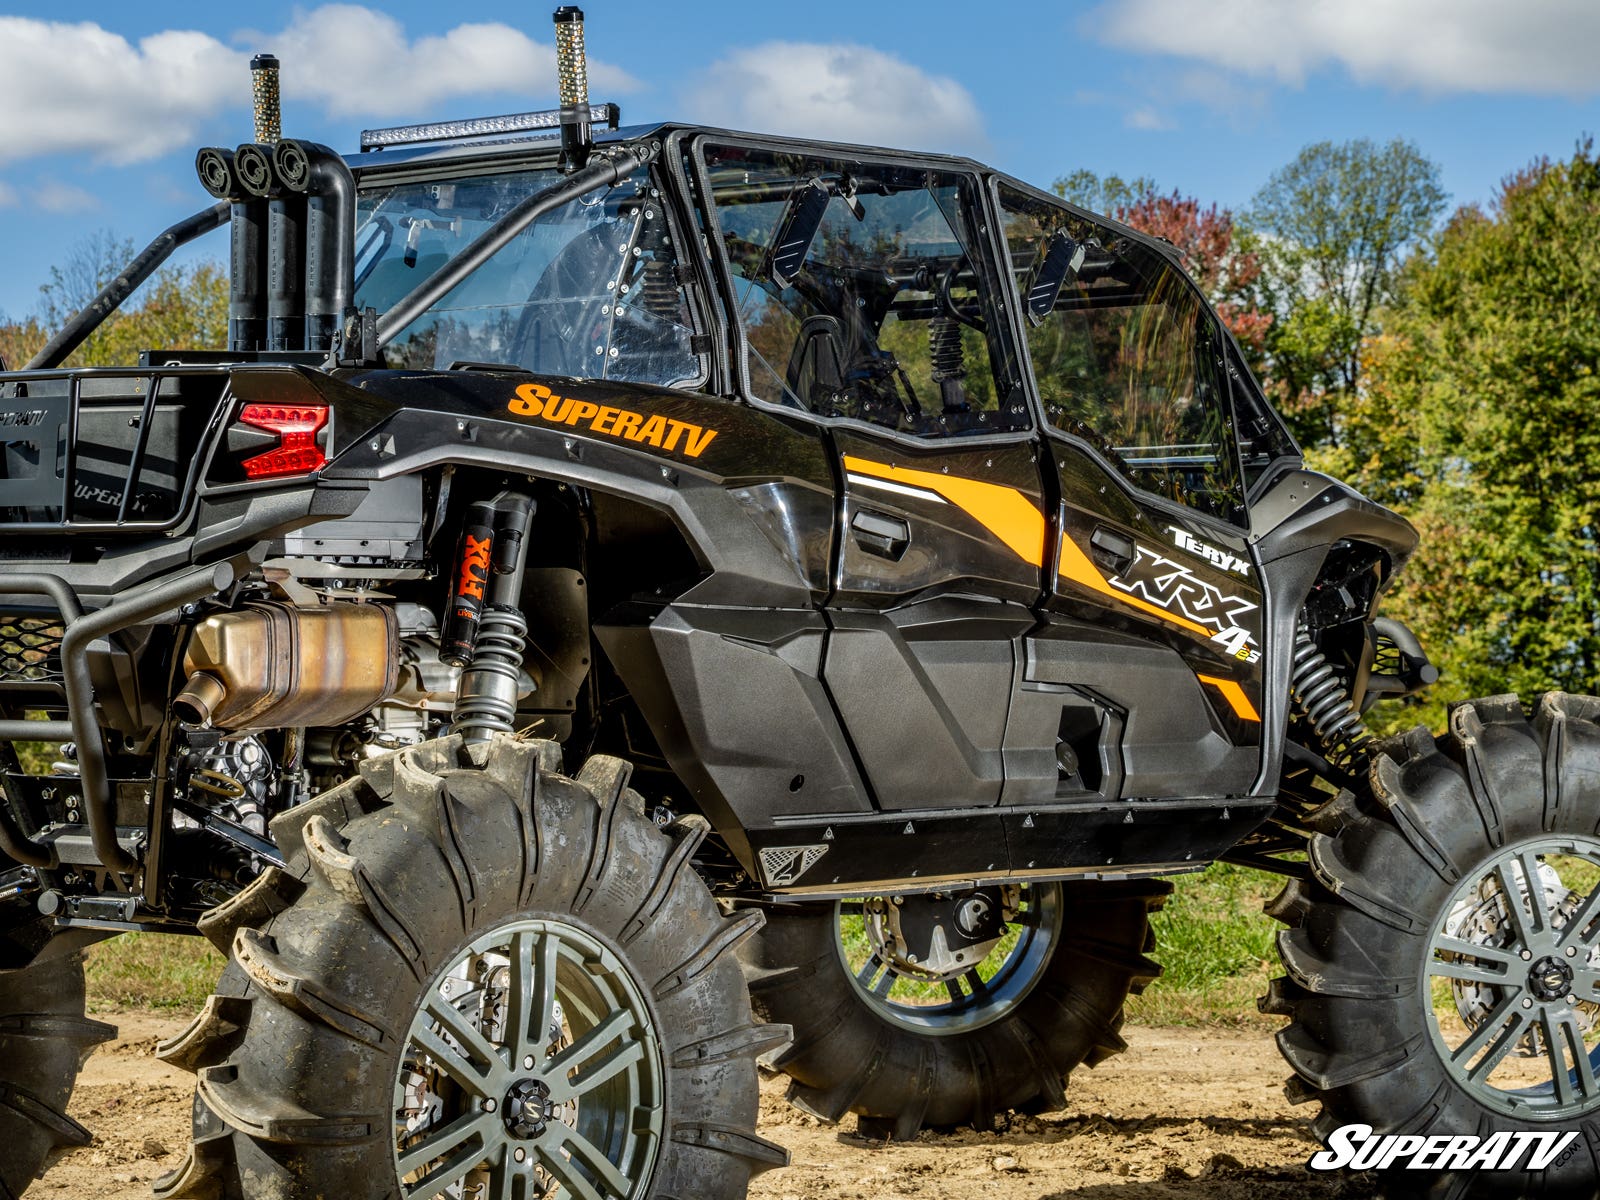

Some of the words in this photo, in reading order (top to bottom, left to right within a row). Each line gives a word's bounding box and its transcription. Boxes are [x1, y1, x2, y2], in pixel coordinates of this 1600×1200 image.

[507, 383, 719, 458] SUPERATV
[459, 535, 491, 600] FOX
[1168, 525, 1253, 576] TERYX
[1108, 545, 1259, 646] KRX
